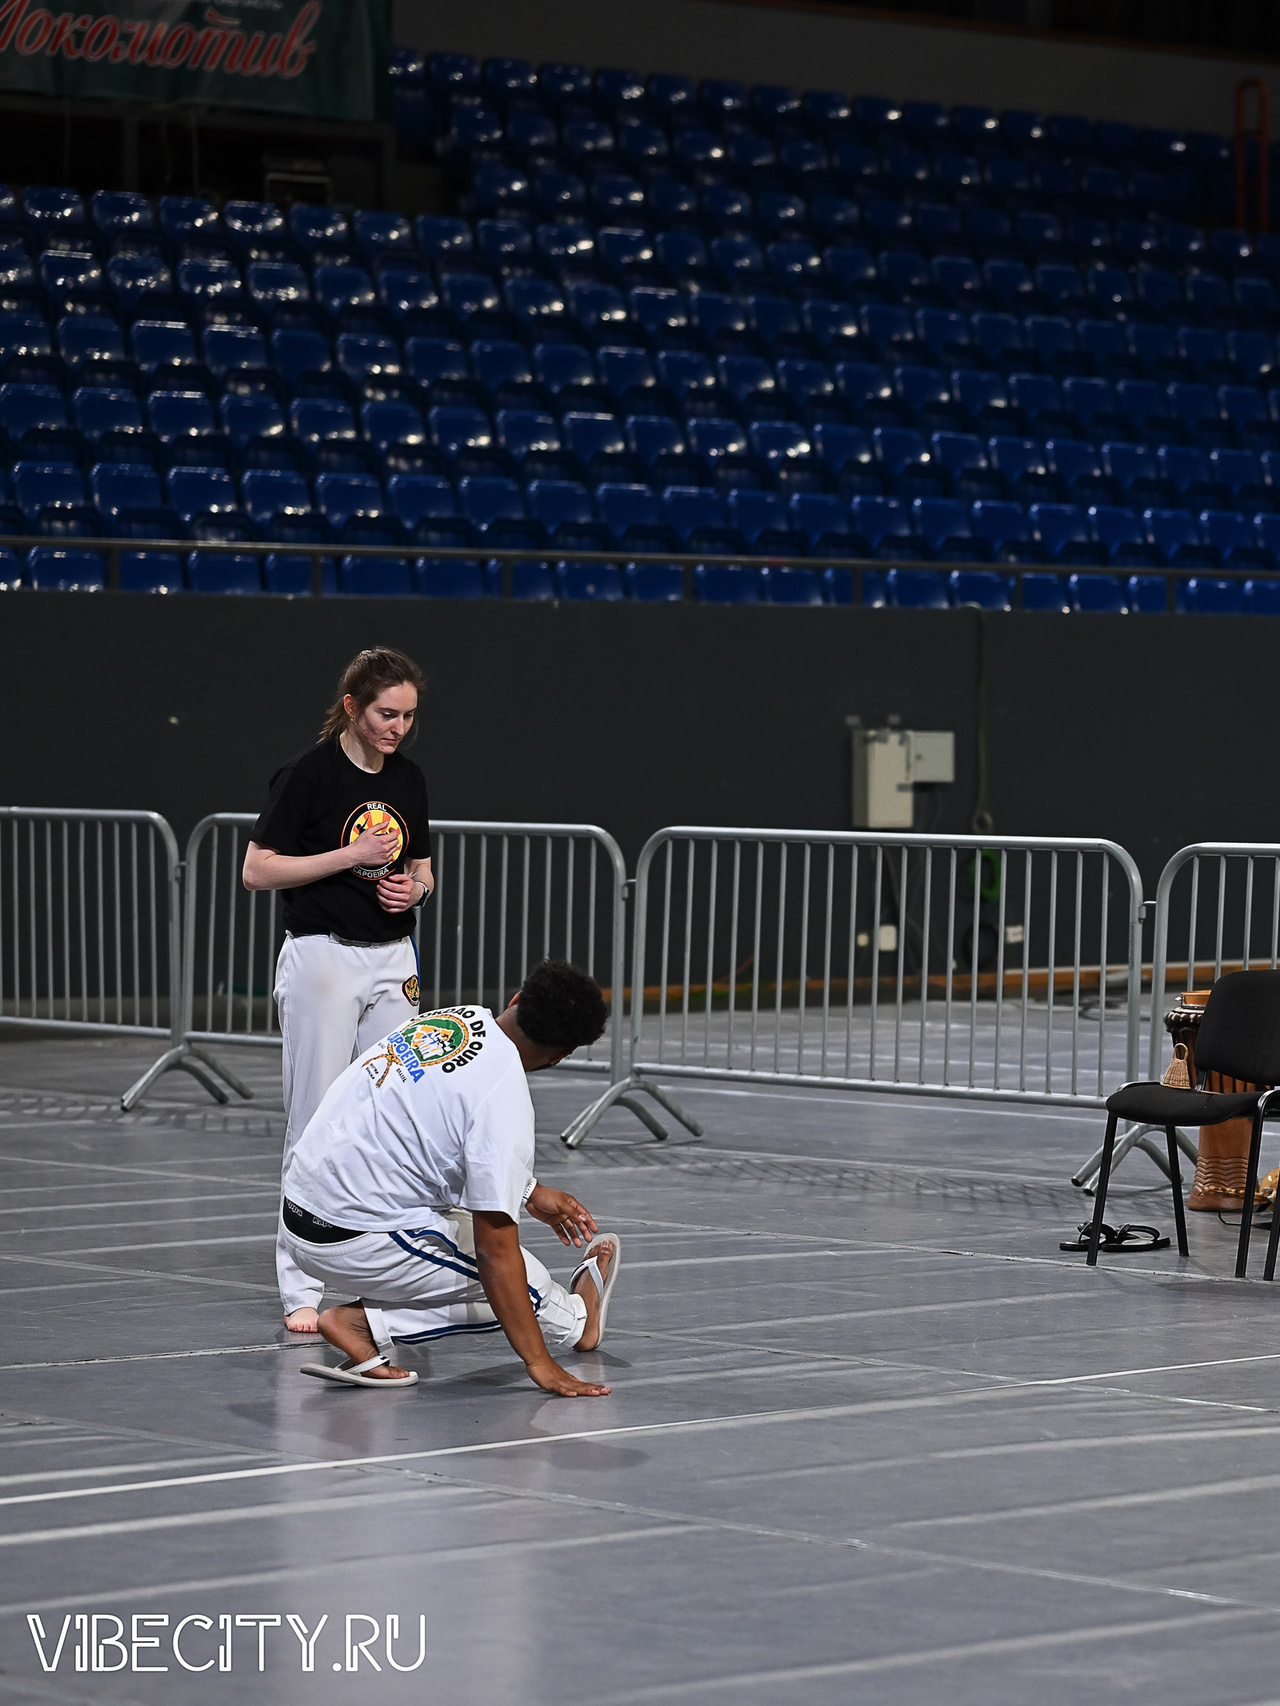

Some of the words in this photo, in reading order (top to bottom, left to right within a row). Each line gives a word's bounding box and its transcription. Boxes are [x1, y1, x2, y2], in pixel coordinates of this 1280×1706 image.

[367, 803, 386, 812] REAL
[352, 866, 389, 878] CAPOEIRA
[470, 1020, 485, 1037] DE
[442, 1042, 483, 1073] OURO
